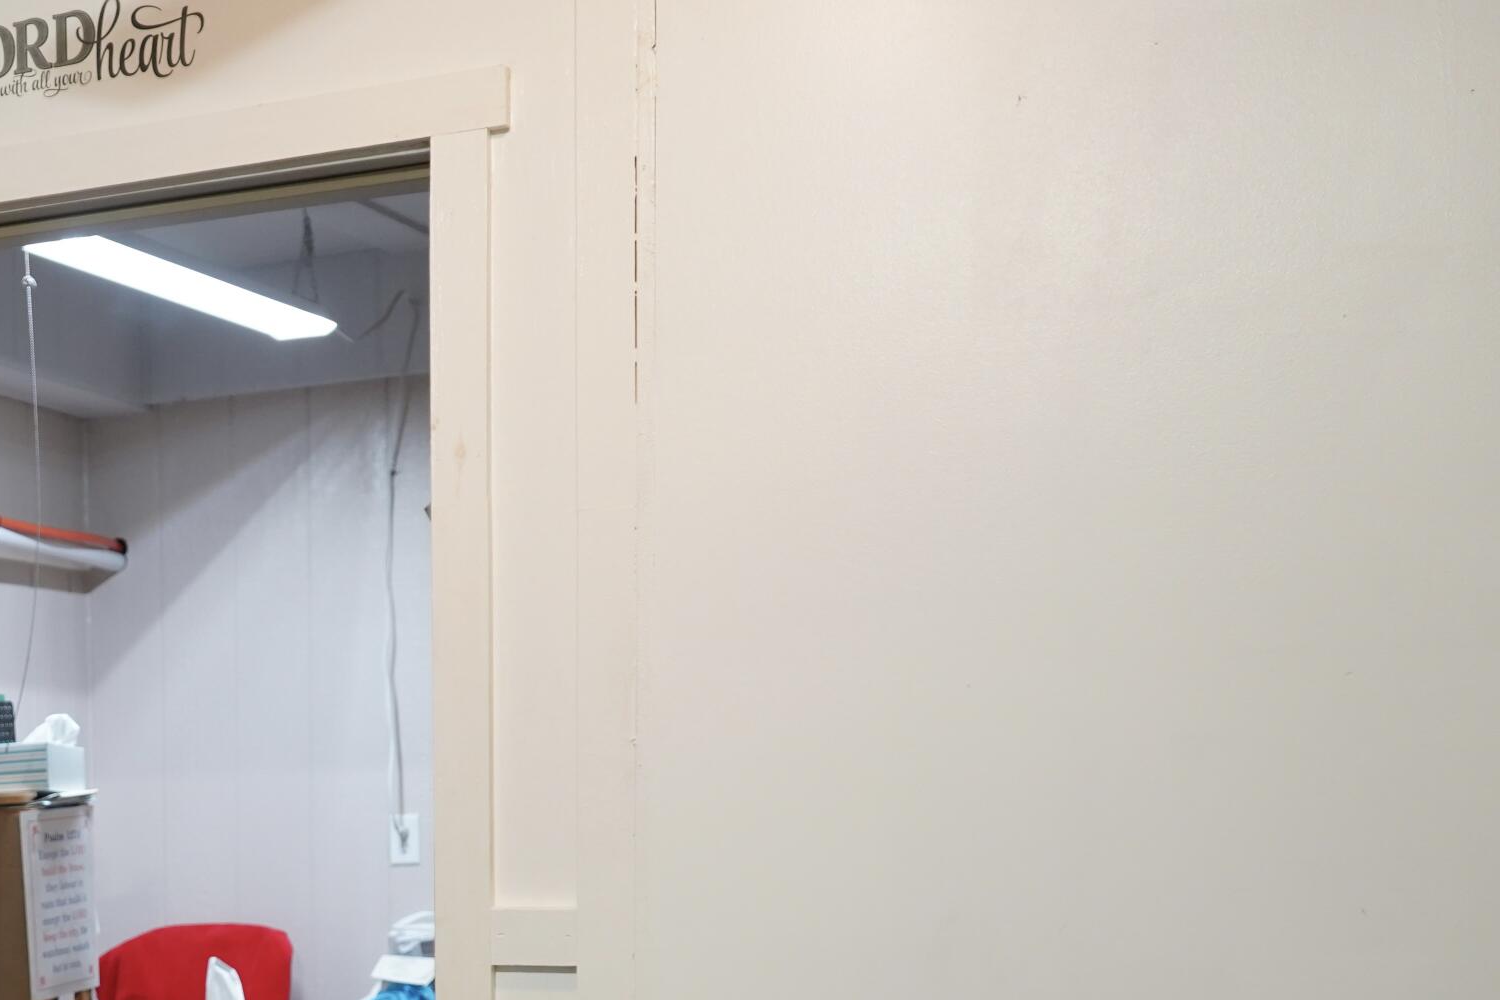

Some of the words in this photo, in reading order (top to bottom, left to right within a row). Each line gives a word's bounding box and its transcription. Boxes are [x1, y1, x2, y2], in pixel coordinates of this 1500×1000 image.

[76, 0, 204, 80] heart
[0, 71, 36, 96] with
[32, 70, 50, 91] all
[43, 70, 93, 97] your
